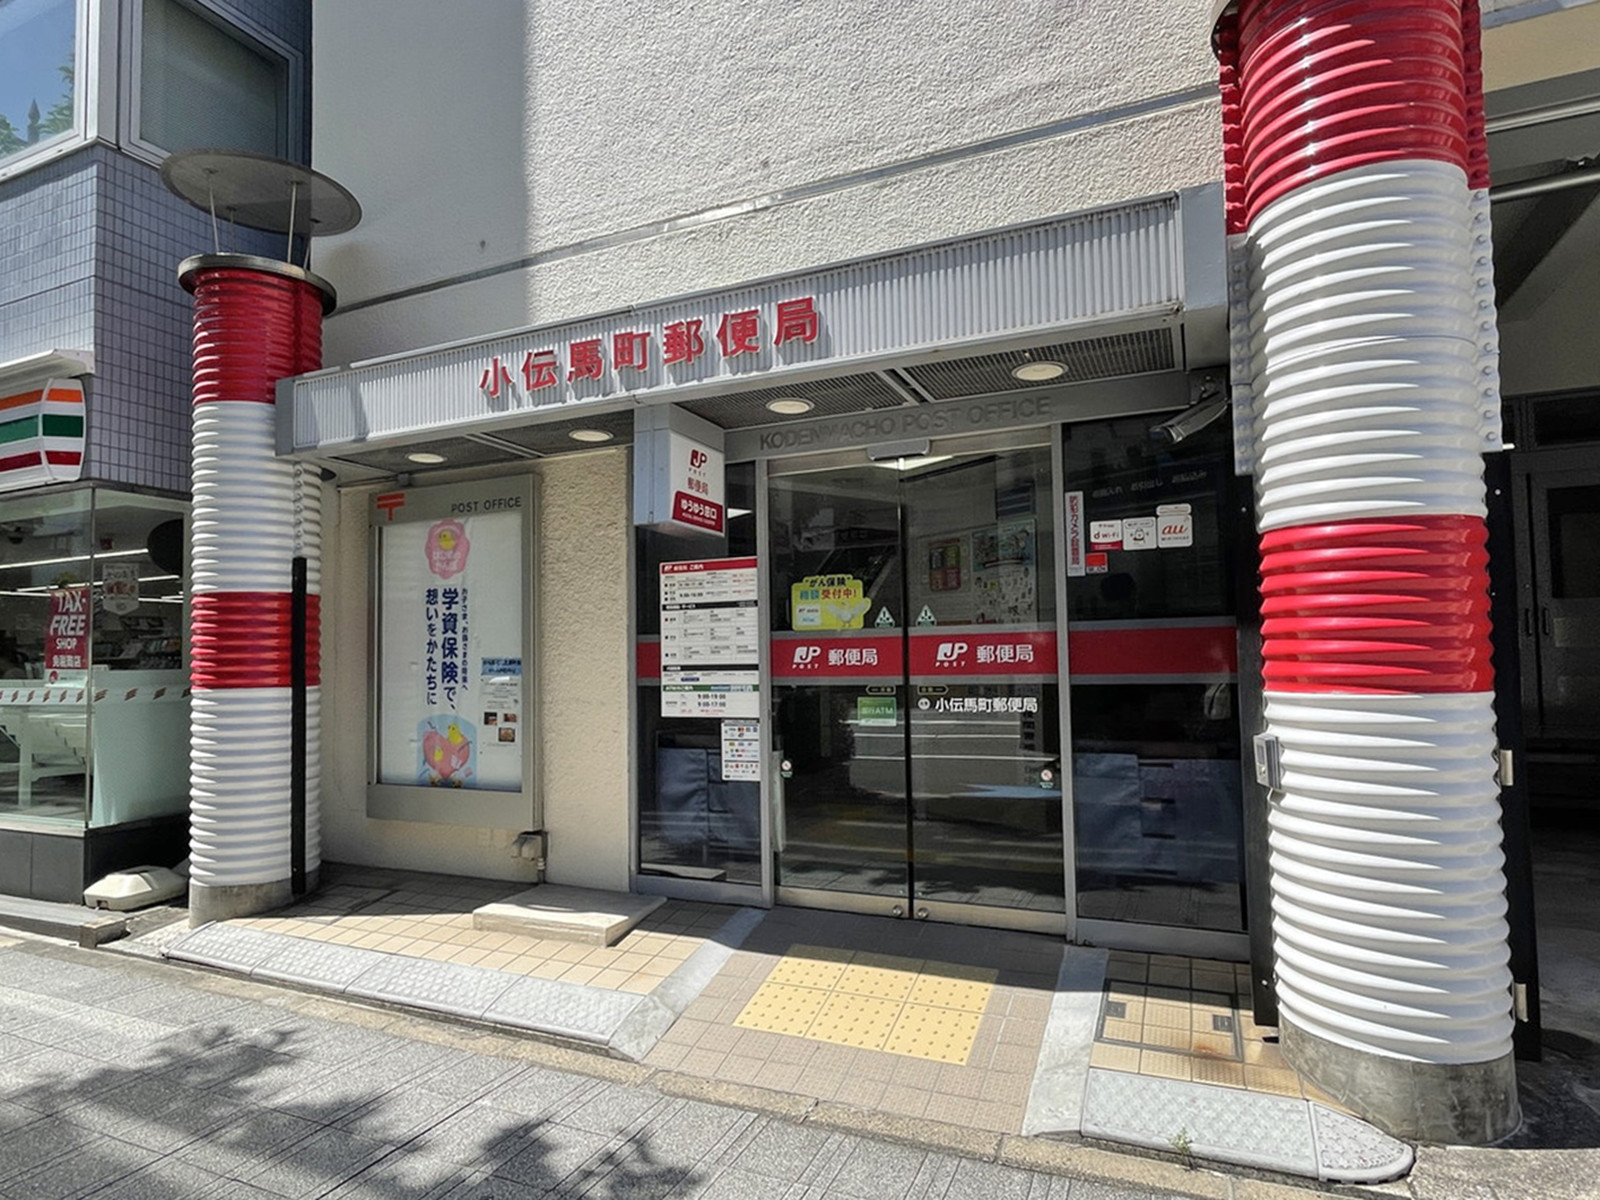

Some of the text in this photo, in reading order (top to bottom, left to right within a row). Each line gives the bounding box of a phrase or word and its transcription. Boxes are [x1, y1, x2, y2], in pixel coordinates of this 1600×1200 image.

[479, 296, 818, 398] 小伝馬町郵便局
[903, 409, 962, 431] POST
[966, 397, 1050, 424] OFFICE
[450, 496, 522, 513] POST OFFICE
[1162, 525, 1188, 536] au
[49, 615, 86, 637] FREE
[56, 638, 77, 650] SHOP
[425, 588, 438, 705] 想いをかたちに
[441, 588, 459, 710] 学資保険で、
[976, 644, 1034, 664] 郵便局
[828, 648, 878, 666] 郵便局
[935, 697, 1038, 713] 小伝馬町郵便局
